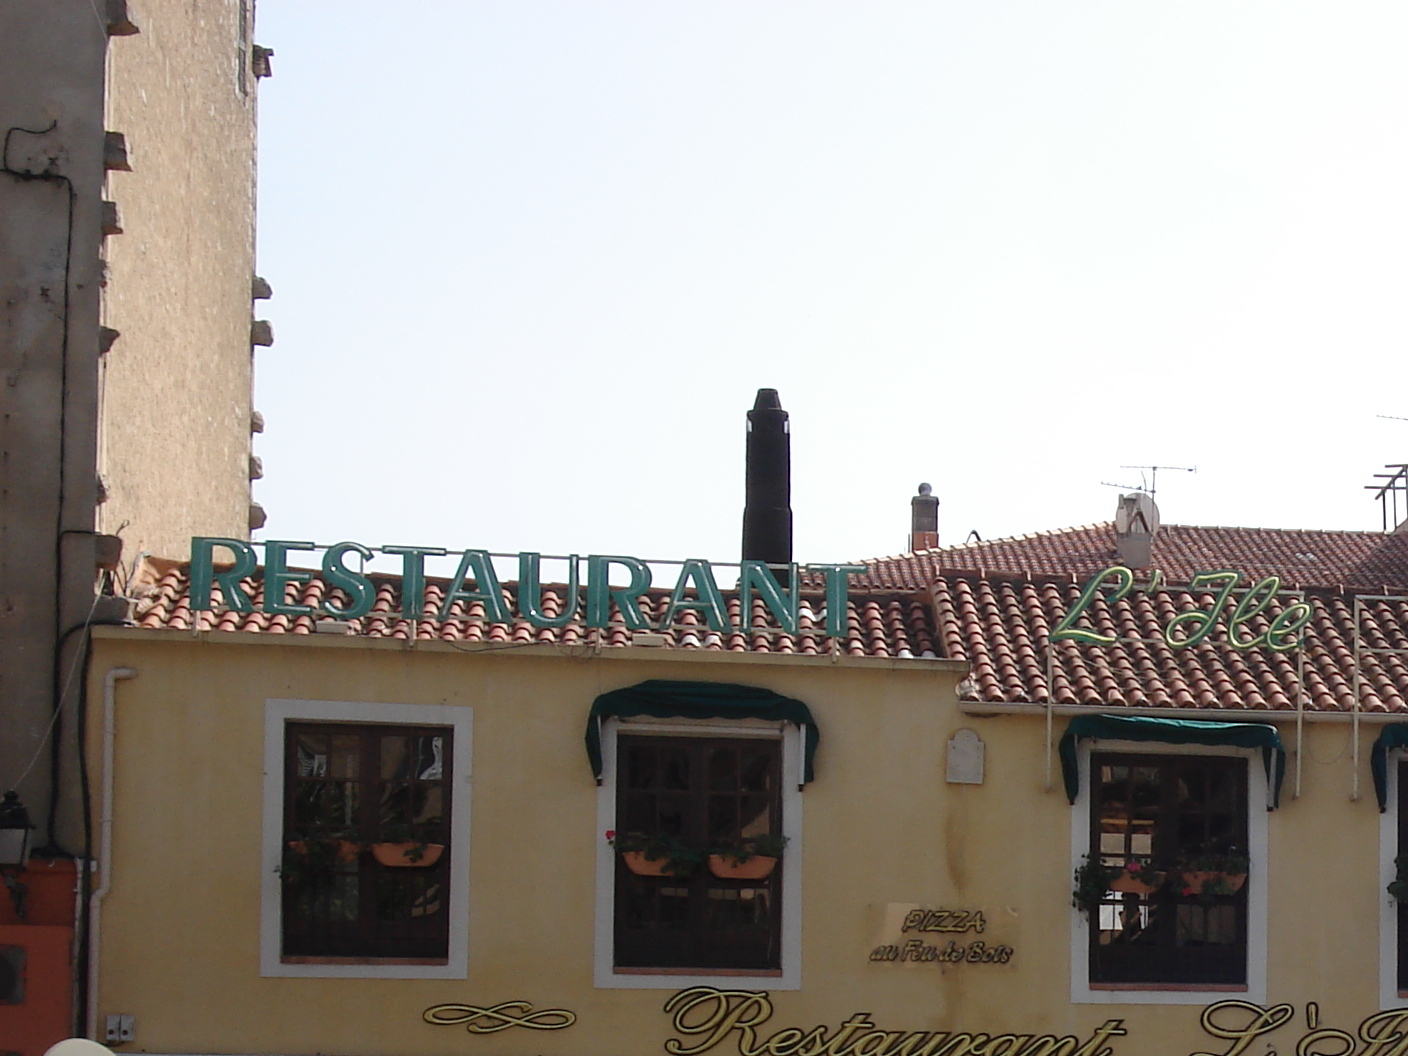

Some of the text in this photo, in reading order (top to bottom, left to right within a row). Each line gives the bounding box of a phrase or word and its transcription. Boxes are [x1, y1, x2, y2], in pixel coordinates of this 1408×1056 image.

[190, 536, 867, 637] RESTAURANT
[902, 909, 987, 933] PIZZA
[901, 939, 937, 963] Feu
[938, 942, 964, 963] de
[967, 941, 1014, 964] Bois
